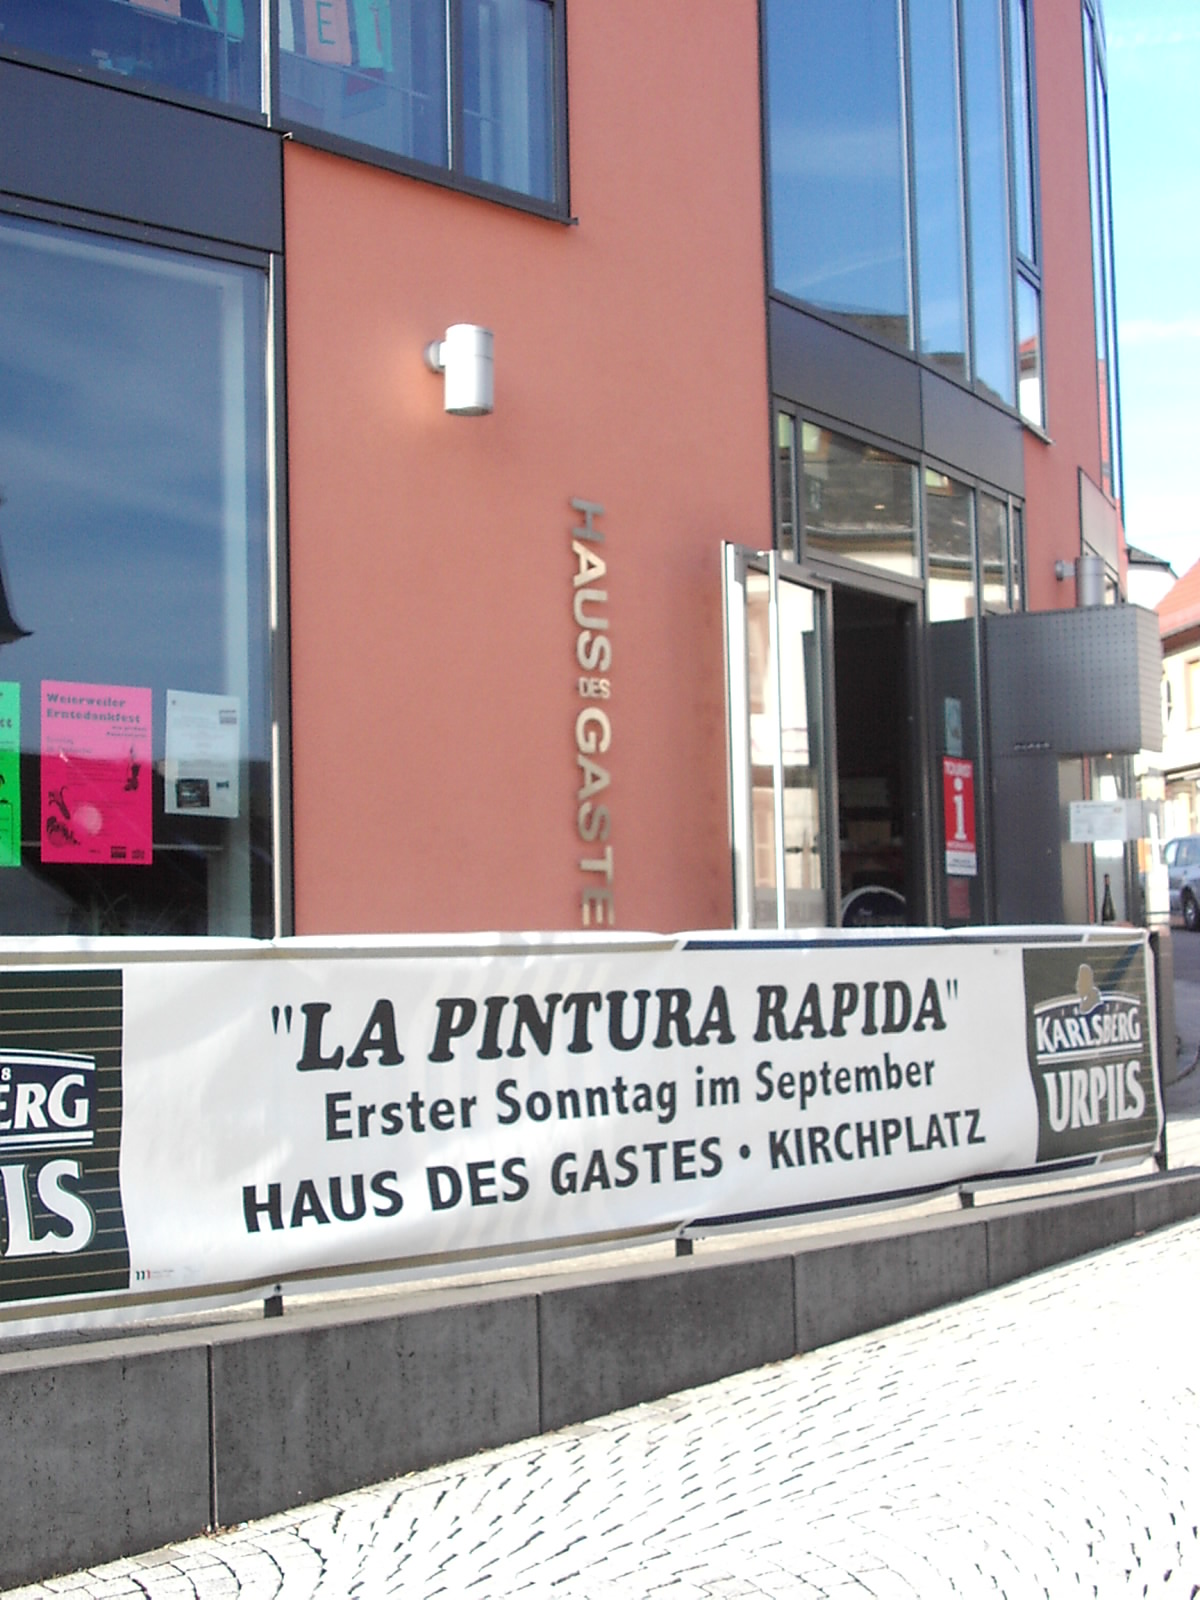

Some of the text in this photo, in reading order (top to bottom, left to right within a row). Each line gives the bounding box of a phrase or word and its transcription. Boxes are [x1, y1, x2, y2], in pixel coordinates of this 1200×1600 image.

[570, 497, 613, 672] HAUS
[46, 708, 140, 723] Erntedankfest
[577, 677, 611, 698] DES
[428, 985, 736, 1063] PINTURA
[1035, 1006, 1141, 1052] KARLSBERG
[325, 1052, 935, 1141] Erster Sonntag im September
[1043, 1059, 1145, 1132] URPILS
[243, 1108, 986, 1233] HAUS DES GASTES KIRCHPLATZ
